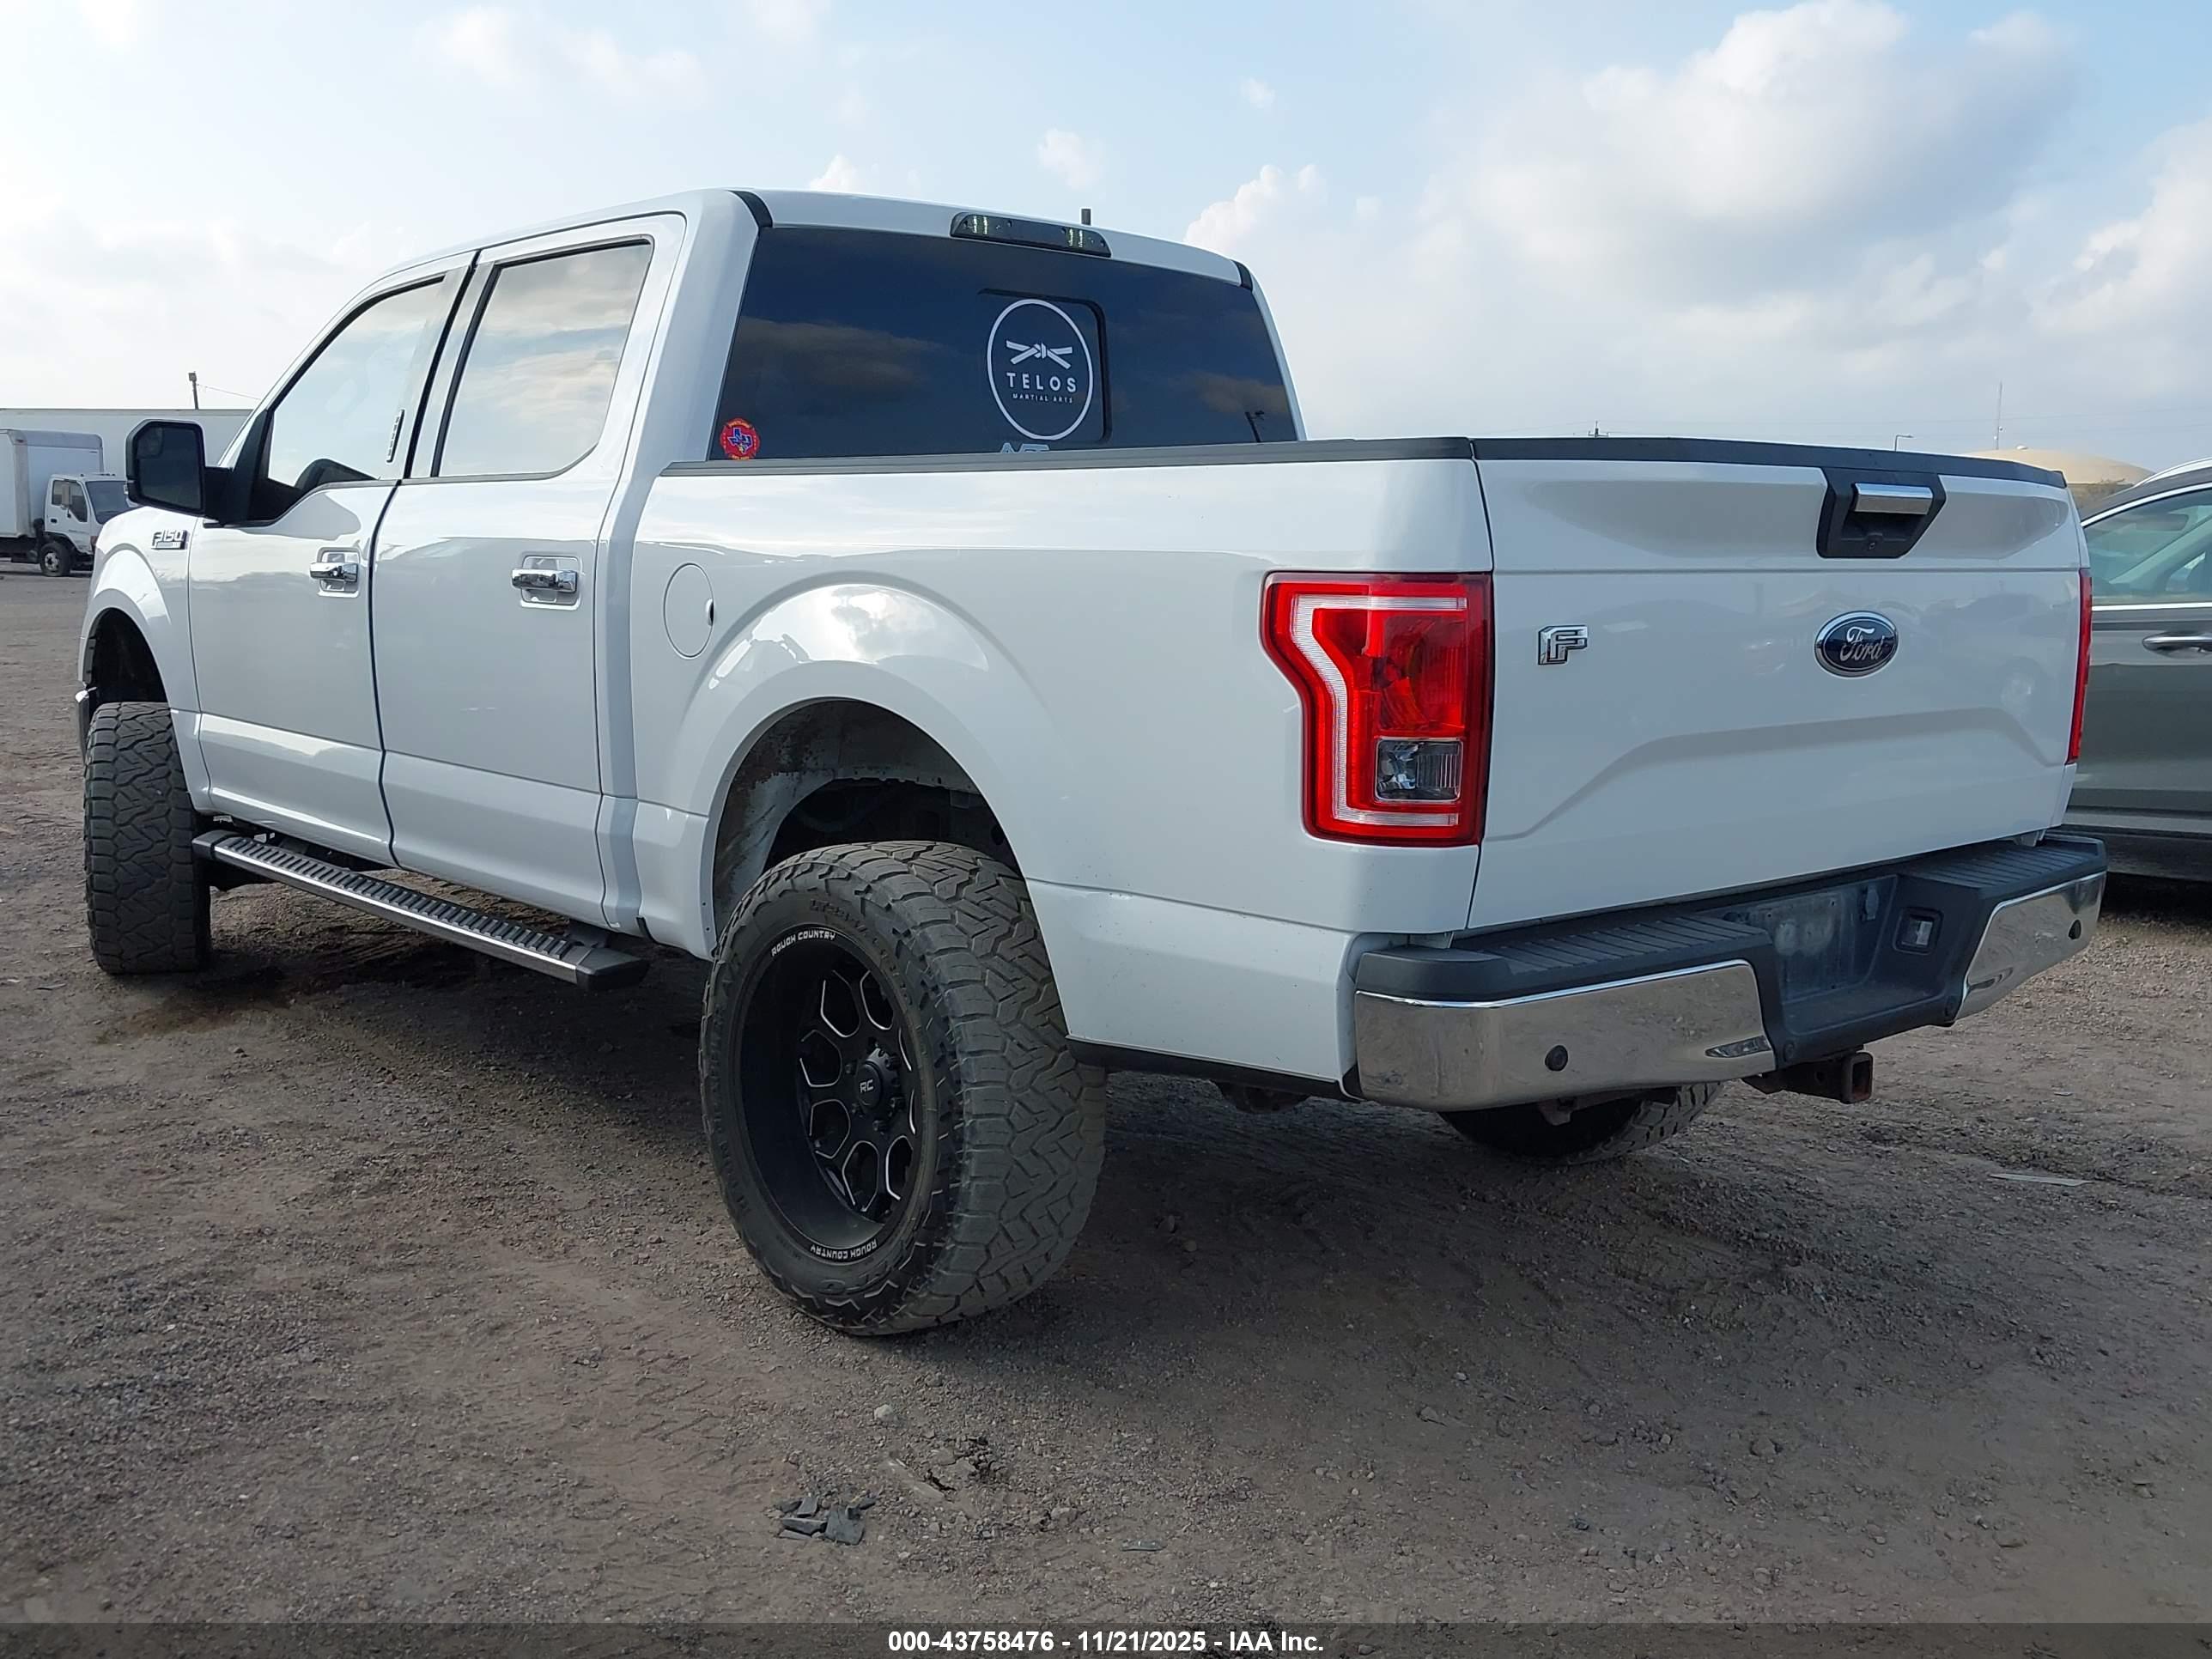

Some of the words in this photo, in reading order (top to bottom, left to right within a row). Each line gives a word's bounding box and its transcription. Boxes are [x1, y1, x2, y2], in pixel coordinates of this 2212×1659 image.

[1006, 372, 1077, 392] TELOS
[1012, 393, 1049, 402] MARTIAL
[1839, 626, 1884, 661] Ford
[771, 935, 796, 957] ROUGH
[798, 930, 836, 940] COUNTRY
[860, 1079, 874, 1093] RC
[810, 1244, 848, 1260] COUNTRY
[850, 1238, 877, 1258] ROUGH
